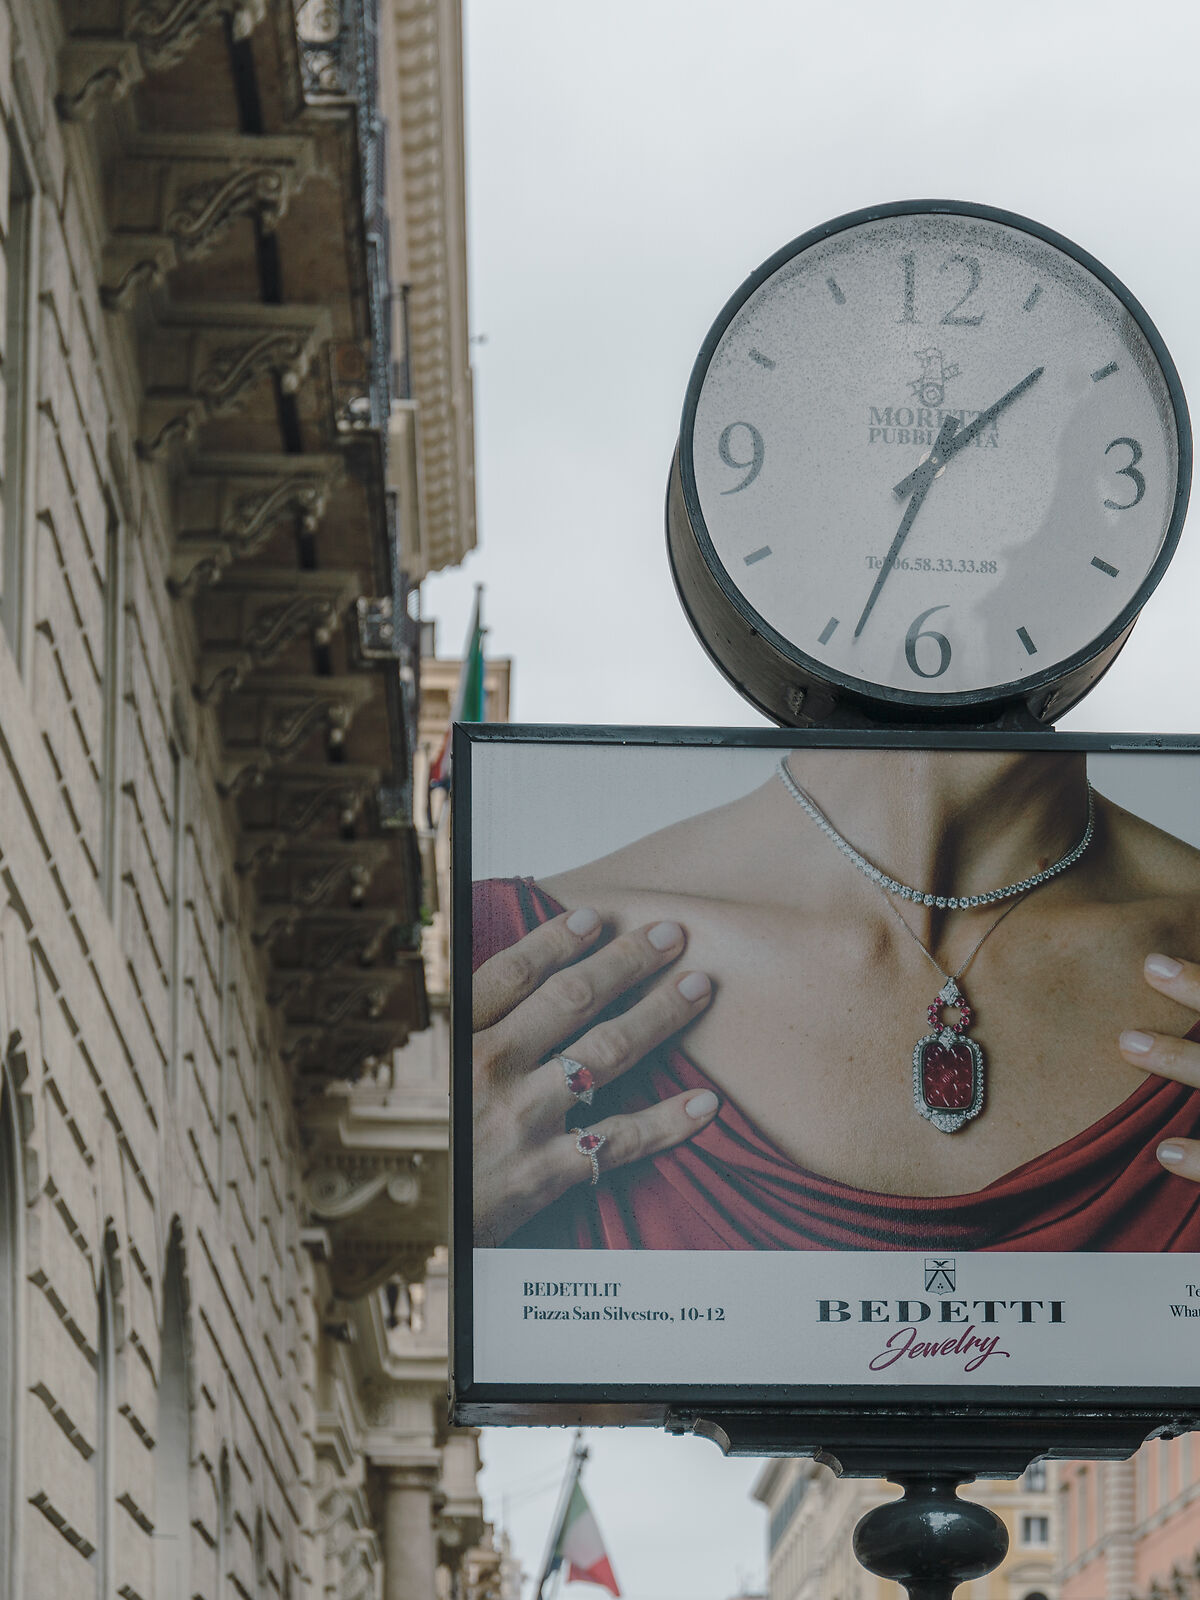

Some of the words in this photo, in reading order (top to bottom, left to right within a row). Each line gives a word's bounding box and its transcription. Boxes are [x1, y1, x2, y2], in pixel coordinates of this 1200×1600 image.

[895, 251, 987, 327] 12
[718, 421, 765, 495] 9
[1103, 436, 1147, 510] 3
[865, 556, 888, 570] Te
[905, 604, 952, 679] 6
[523, 1282, 621, 1297] BEDETTI.IT
[816, 1300, 1066, 1323] BEDETTI
[523, 1305, 569, 1321] Piazza
[572, 1306, 600, 1321] San
[603, 1306, 675, 1323] Silvestro,
[680, 1306, 726, 1322] 10-12
[869, 1325, 1011, 1372] Jewelry
